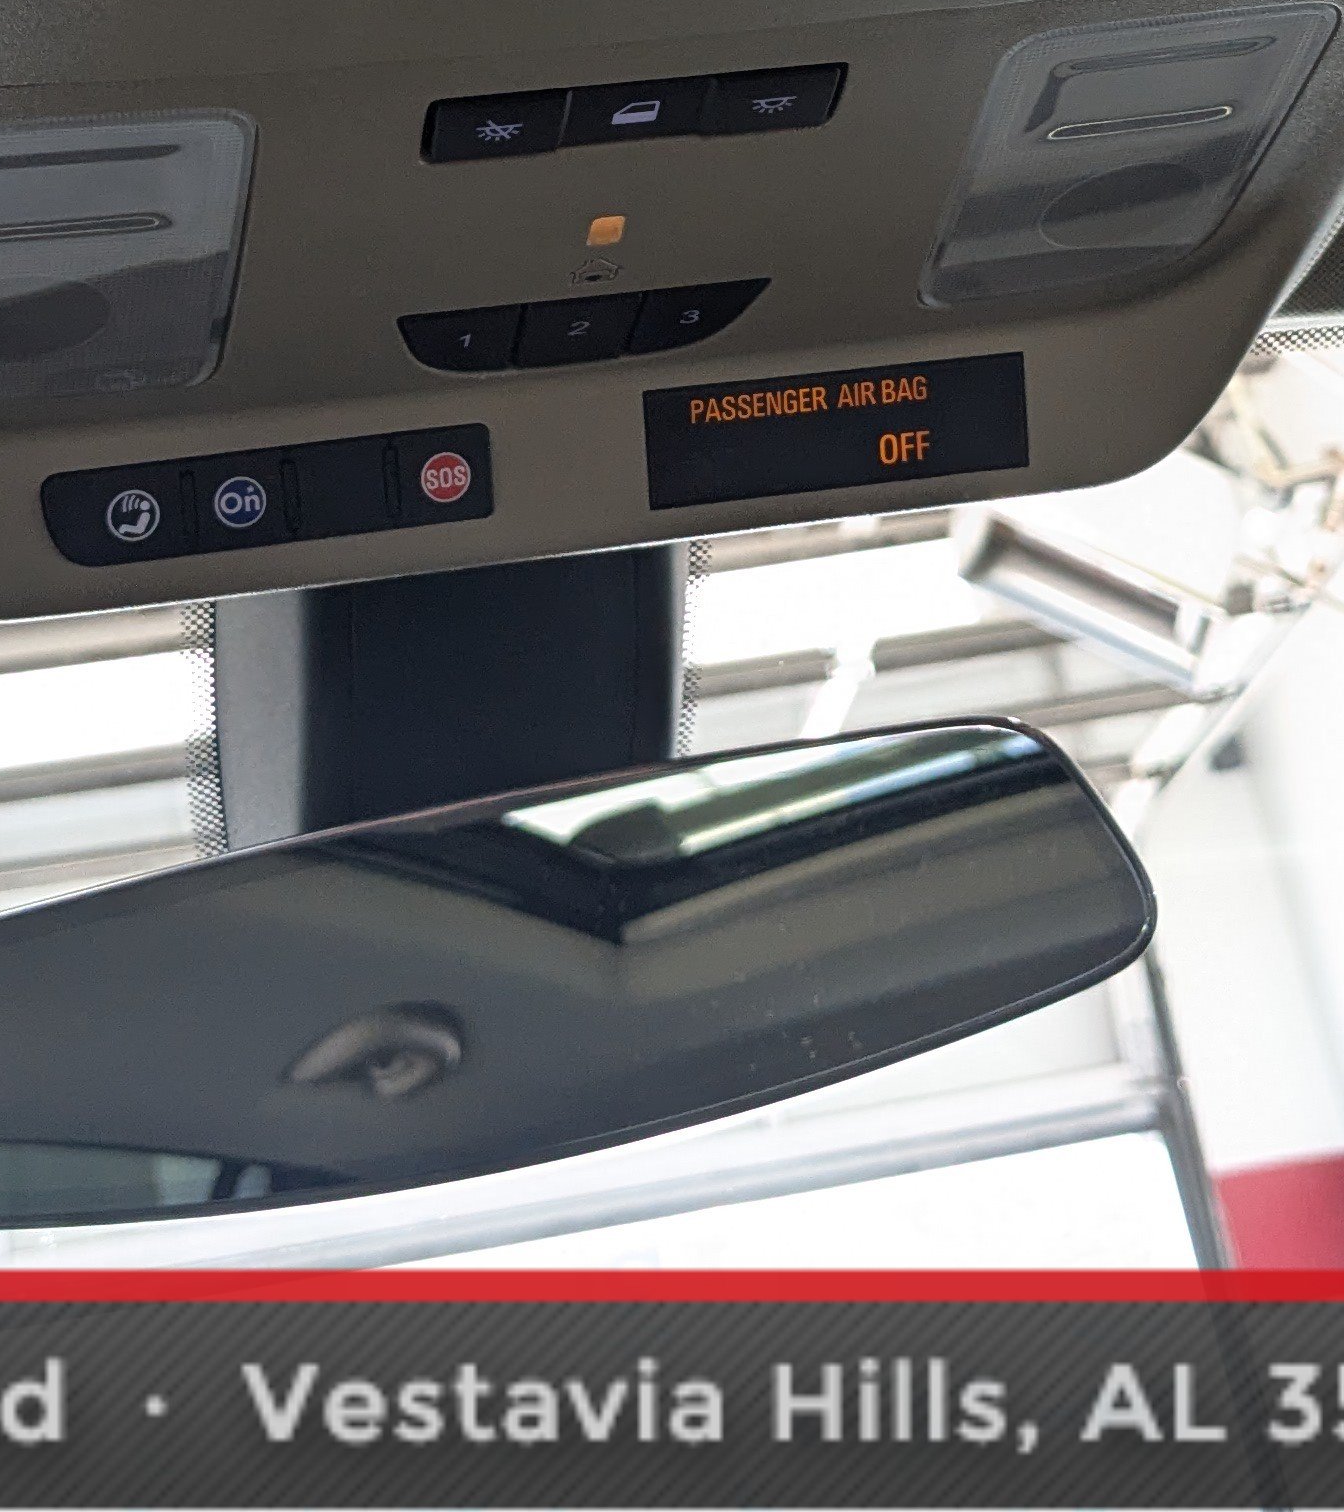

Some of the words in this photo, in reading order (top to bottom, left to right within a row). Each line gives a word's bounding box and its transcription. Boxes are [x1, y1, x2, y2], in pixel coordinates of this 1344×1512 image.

[460, 333, 471, 348] 1
[567, 321, 591, 336] 2
[679, 309, 700, 324] 3
[690, 386, 828, 424] PASSENGER
[836, 381, 877, 410] AIR
[880, 375, 928, 404] BAG
[878, 430, 931, 465] OFF
[425, 464, 467, 491] SOS
[220, 489, 261, 516] On
